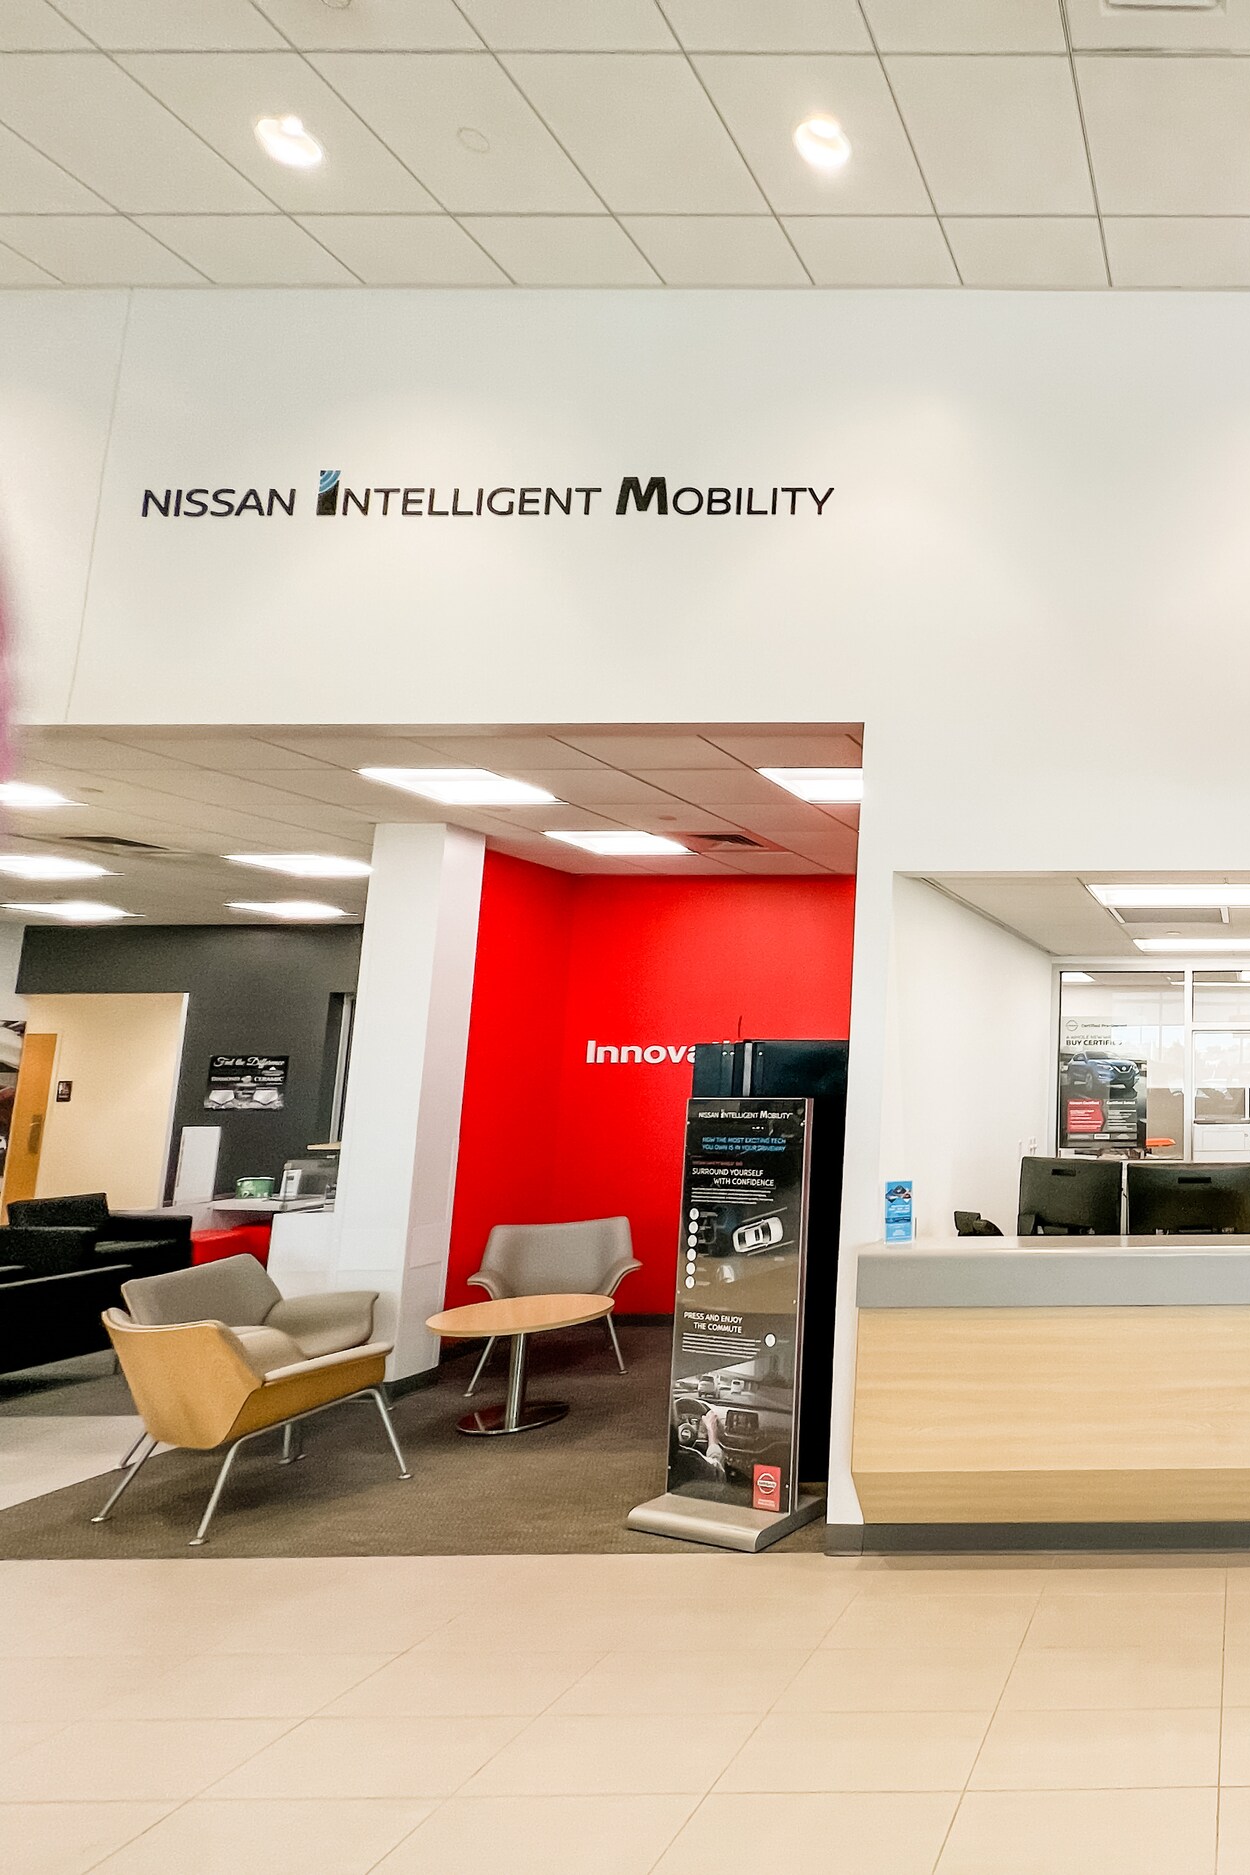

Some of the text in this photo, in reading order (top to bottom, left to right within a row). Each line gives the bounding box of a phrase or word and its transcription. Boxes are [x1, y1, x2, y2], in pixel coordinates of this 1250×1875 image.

[141, 469, 835, 517] NISSAN INTELLIGENT MOBILITY
[720, 1109, 758, 1119] INTELLIGENT
[692, 1168, 764, 1177] SURROUND YOURSELF
[713, 1177, 775, 1187] WITH CONFIDENCE
[683, 1311, 743, 1324] PRESS AND ENJOY
[693, 1322, 743, 1333] THE COMMUTE
